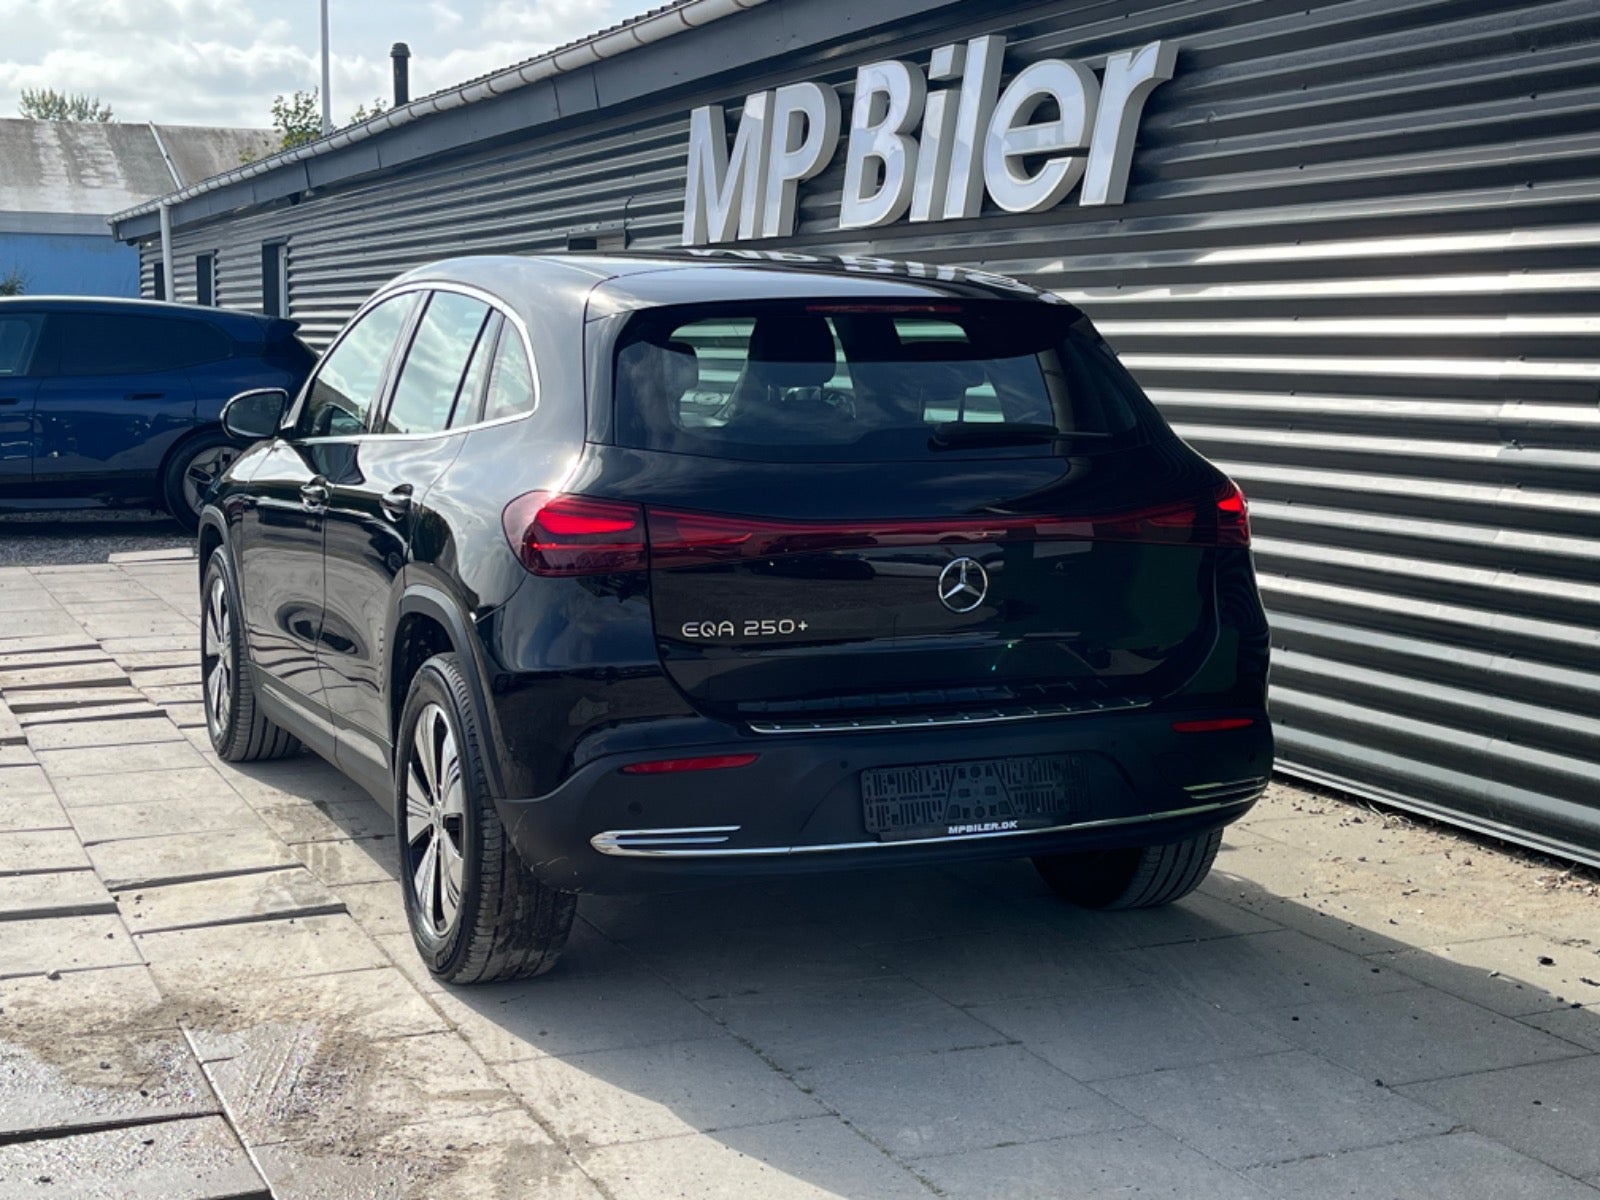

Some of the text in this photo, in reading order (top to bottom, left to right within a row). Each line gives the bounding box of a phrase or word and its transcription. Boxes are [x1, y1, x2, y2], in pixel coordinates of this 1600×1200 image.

[682, 35, 1179, 246] MP Biler
[682, 619, 808, 637] EQA 250+
[948, 820, 1018, 834] MPBILER.DK
